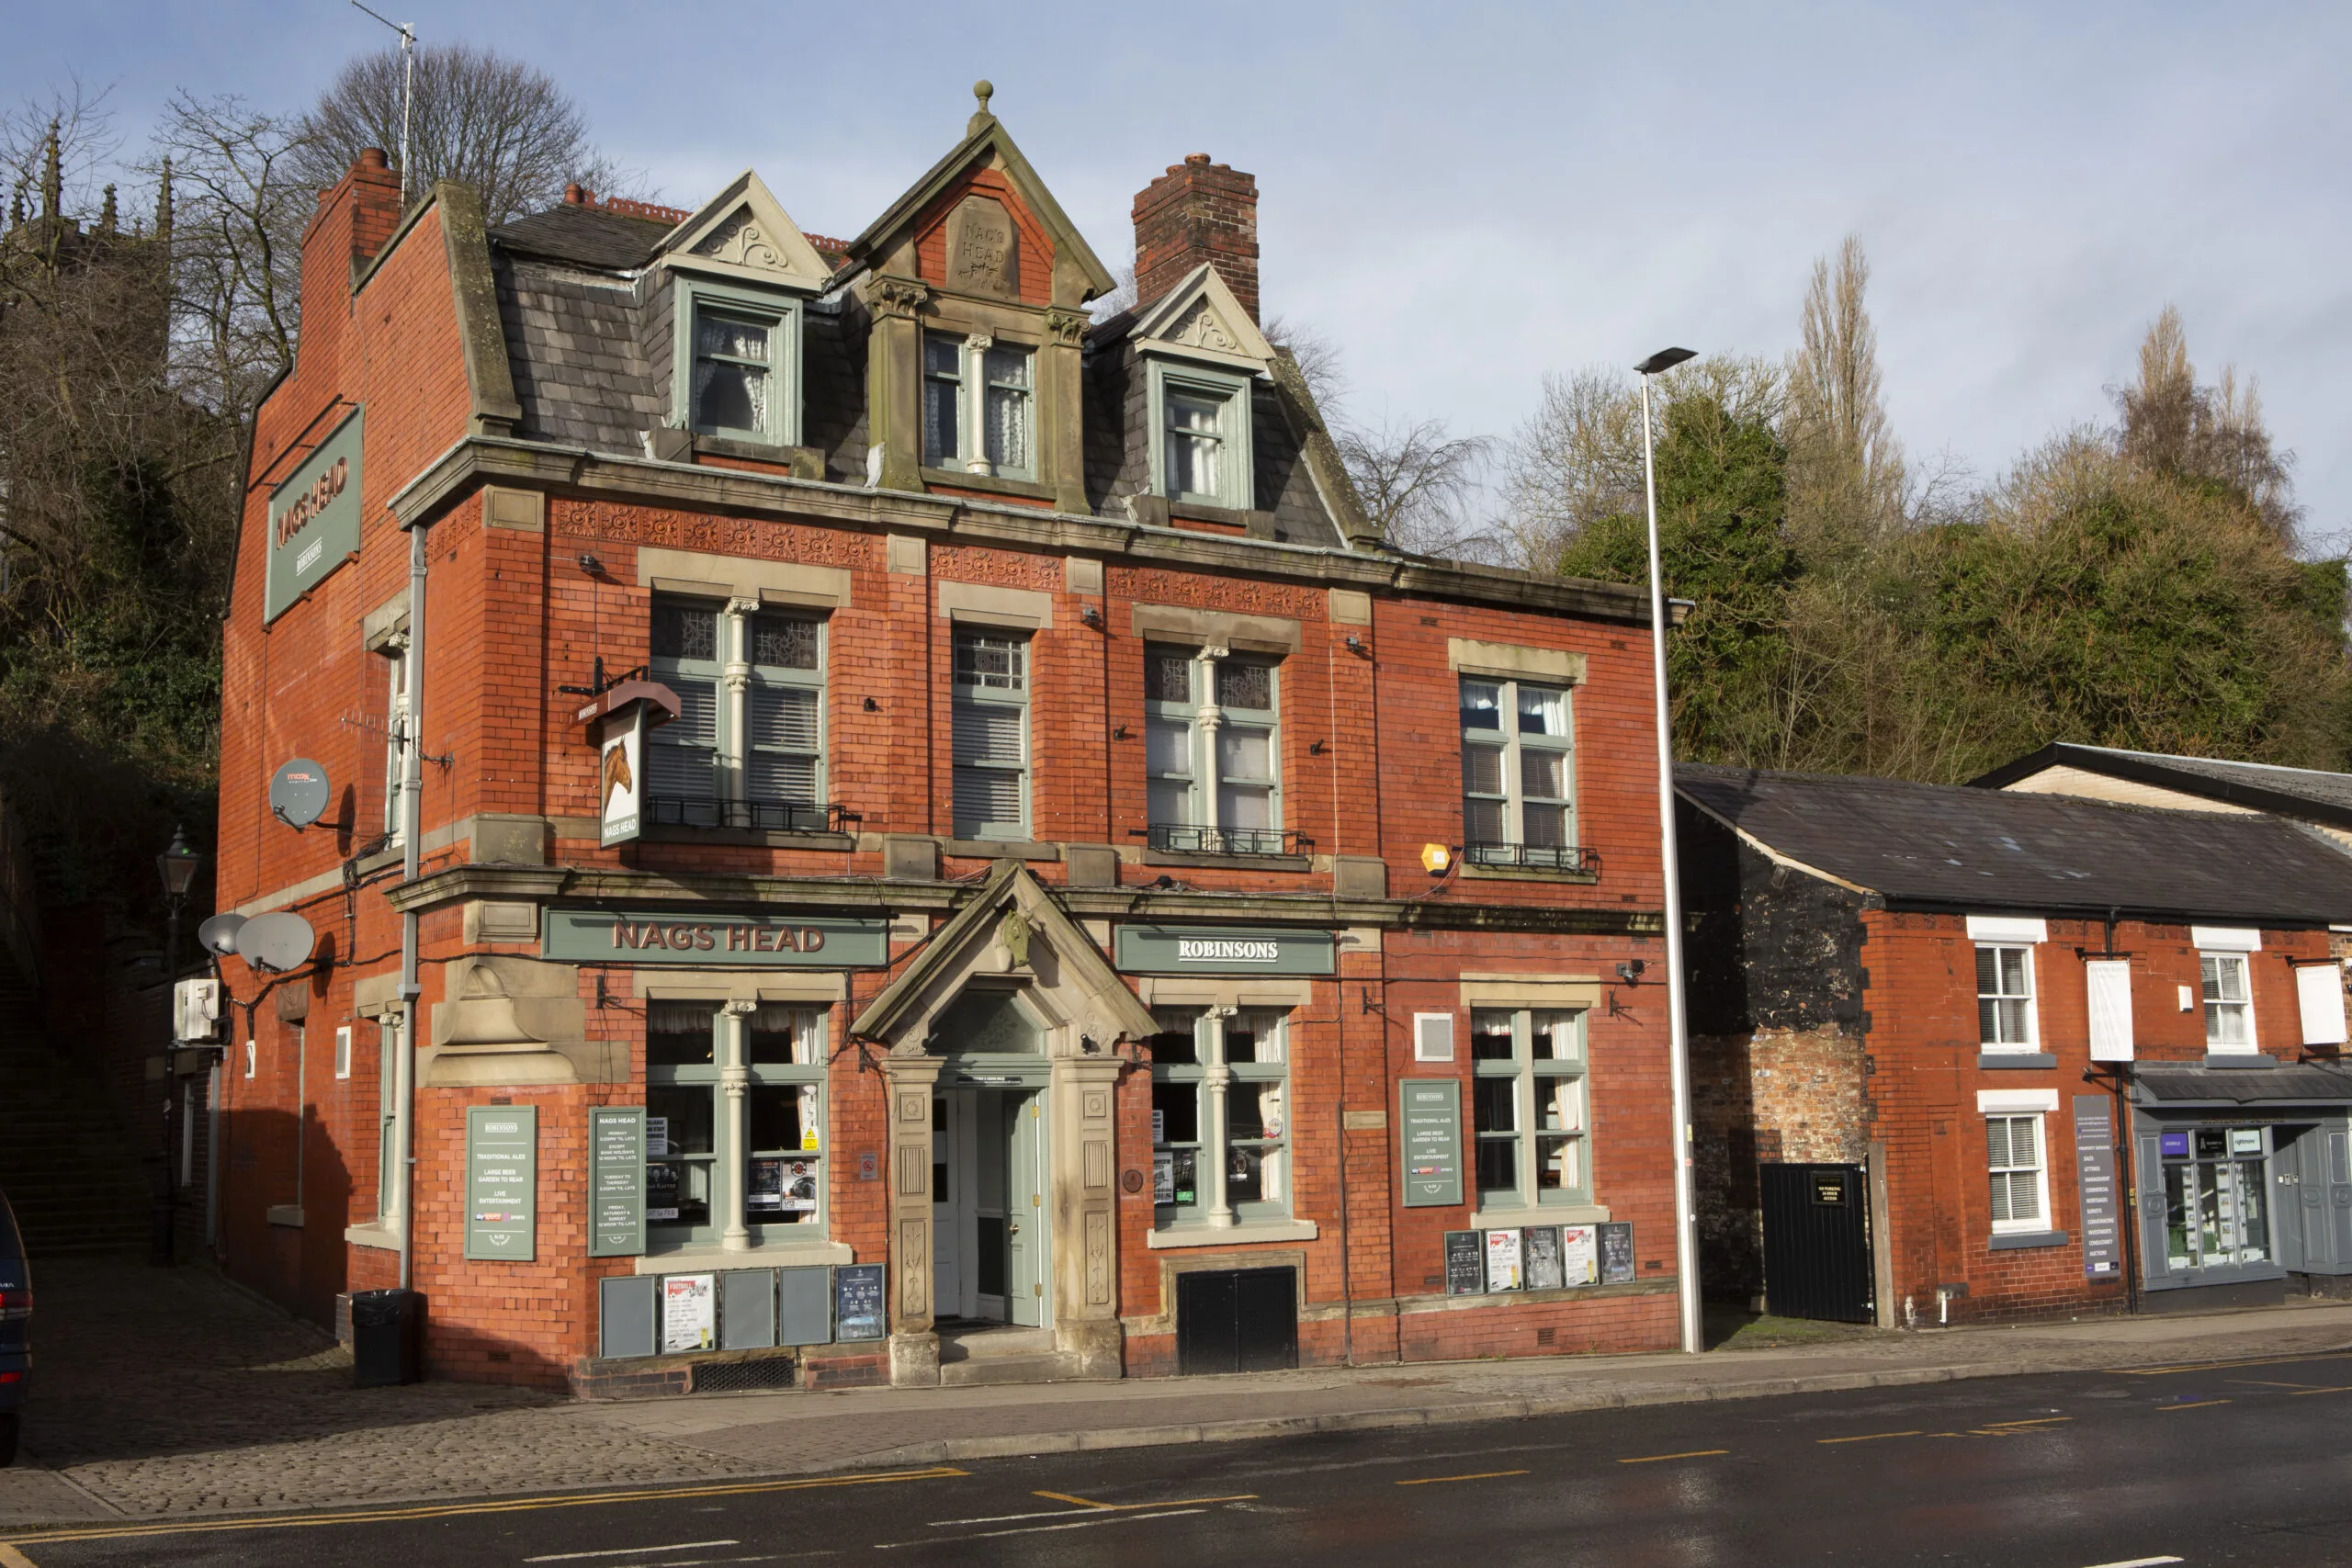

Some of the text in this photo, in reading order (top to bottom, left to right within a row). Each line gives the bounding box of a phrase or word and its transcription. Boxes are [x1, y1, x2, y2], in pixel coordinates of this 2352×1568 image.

[963, 242, 1004, 263] HEAD
[277, 457, 347, 550] NAGS HEAD
[296, 539, 322, 573] ROBINSONS
[605, 818, 636, 838] NAGS HEAD
[613, 921, 825, 953] NAGS HEAD
[1178, 940, 1279, 959] ROBINSONS
[485, 1123, 517, 1132] ROBINSONS
